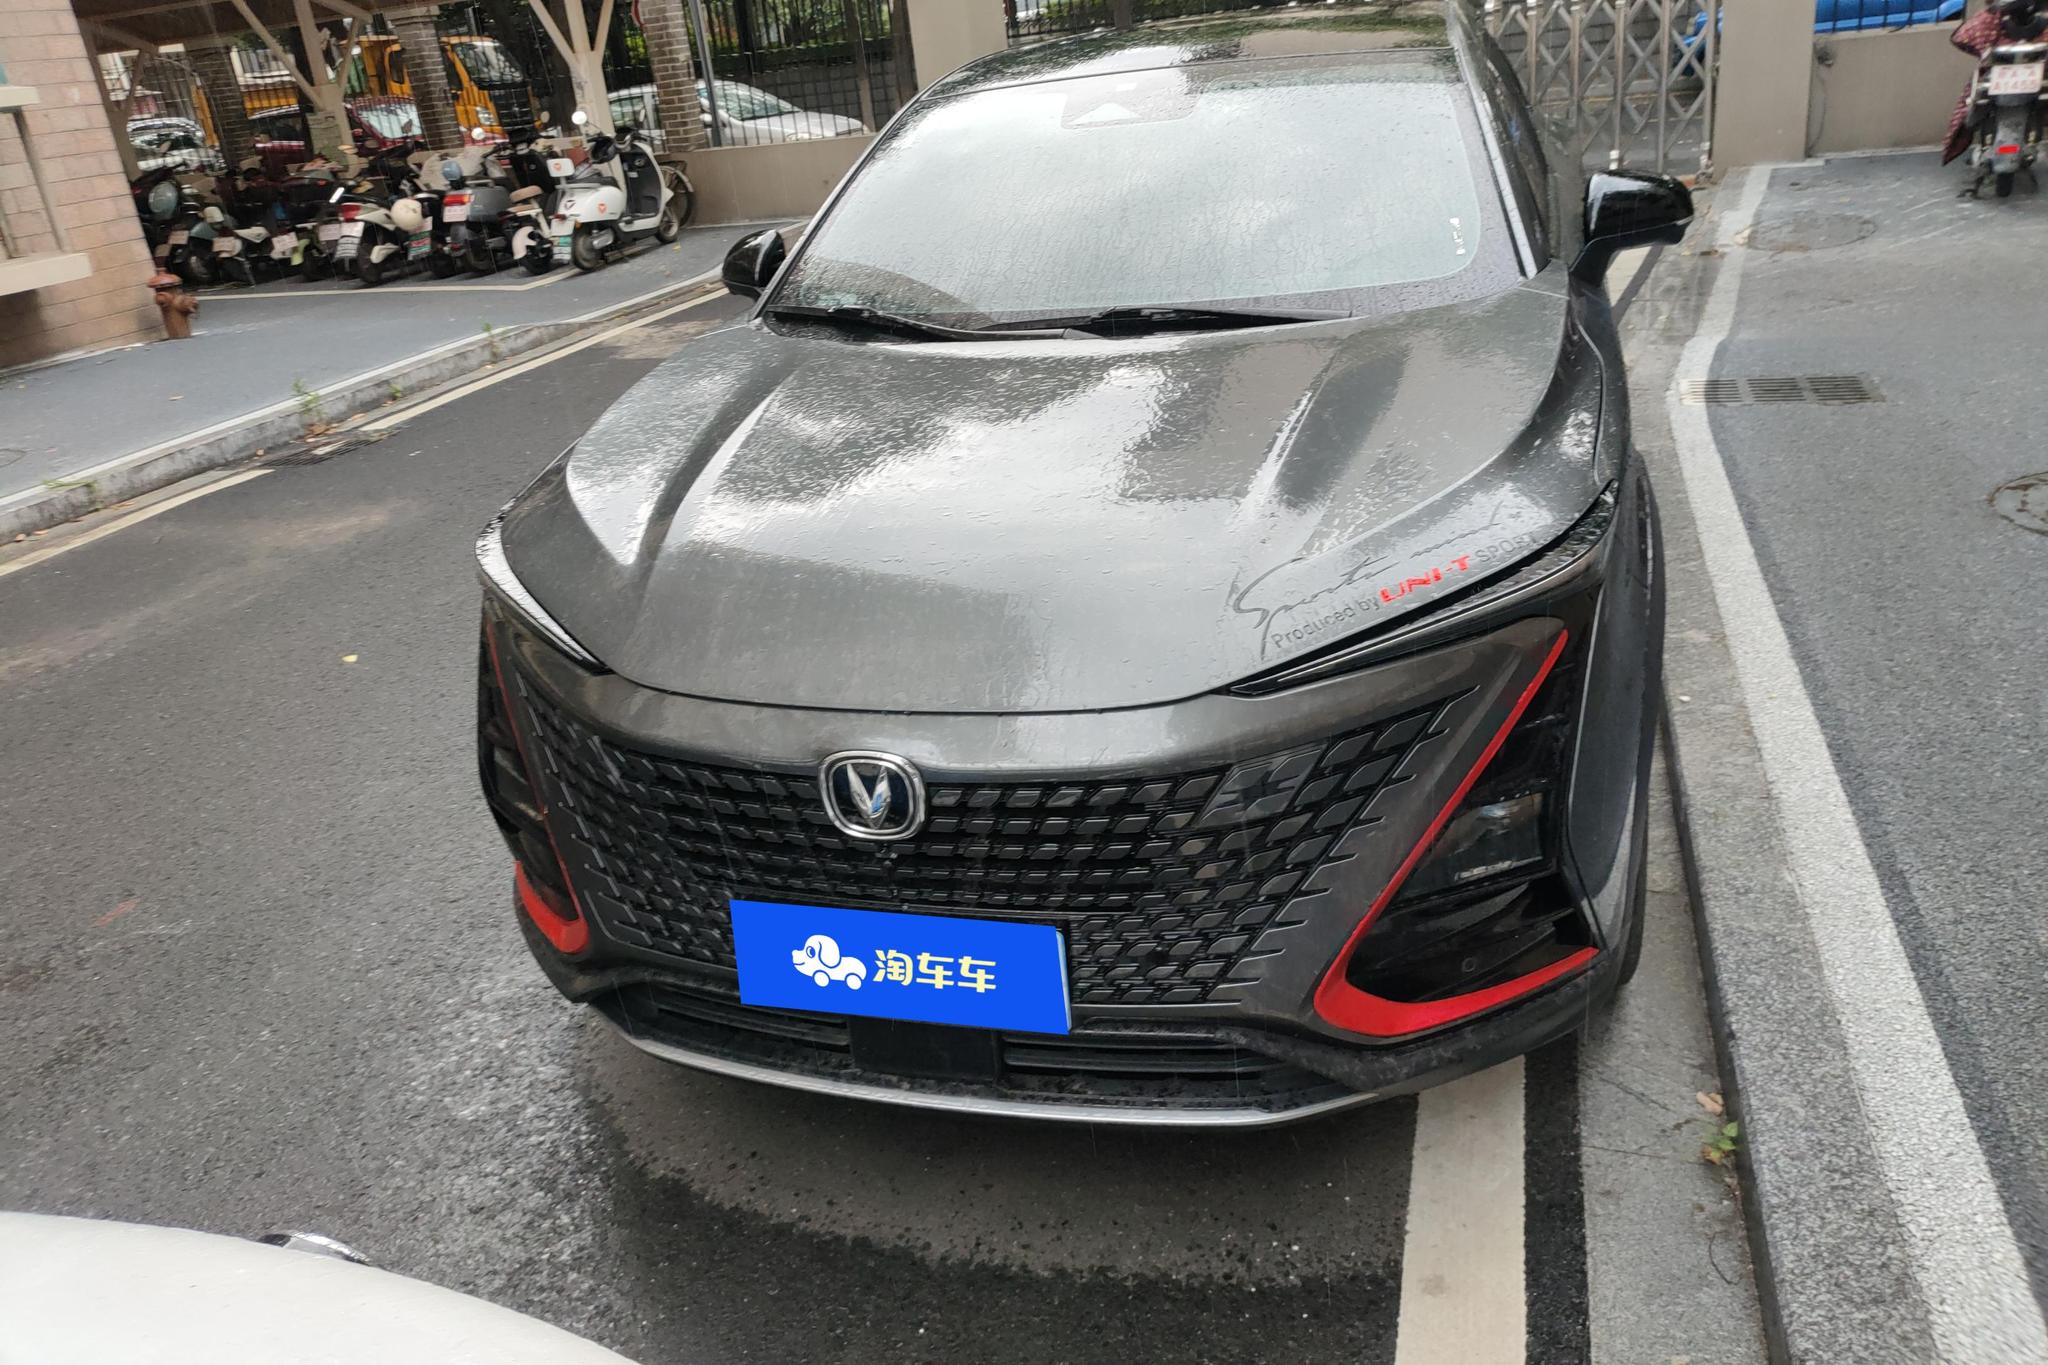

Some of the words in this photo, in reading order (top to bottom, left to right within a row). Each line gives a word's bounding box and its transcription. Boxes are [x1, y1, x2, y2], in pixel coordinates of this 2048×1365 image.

[1271, 602, 1356, 648] Produced
[1354, 597, 1380, 613] by
[1380, 555, 1471, 603] UNI-T
[1475, 530, 1540, 562] SPORT
